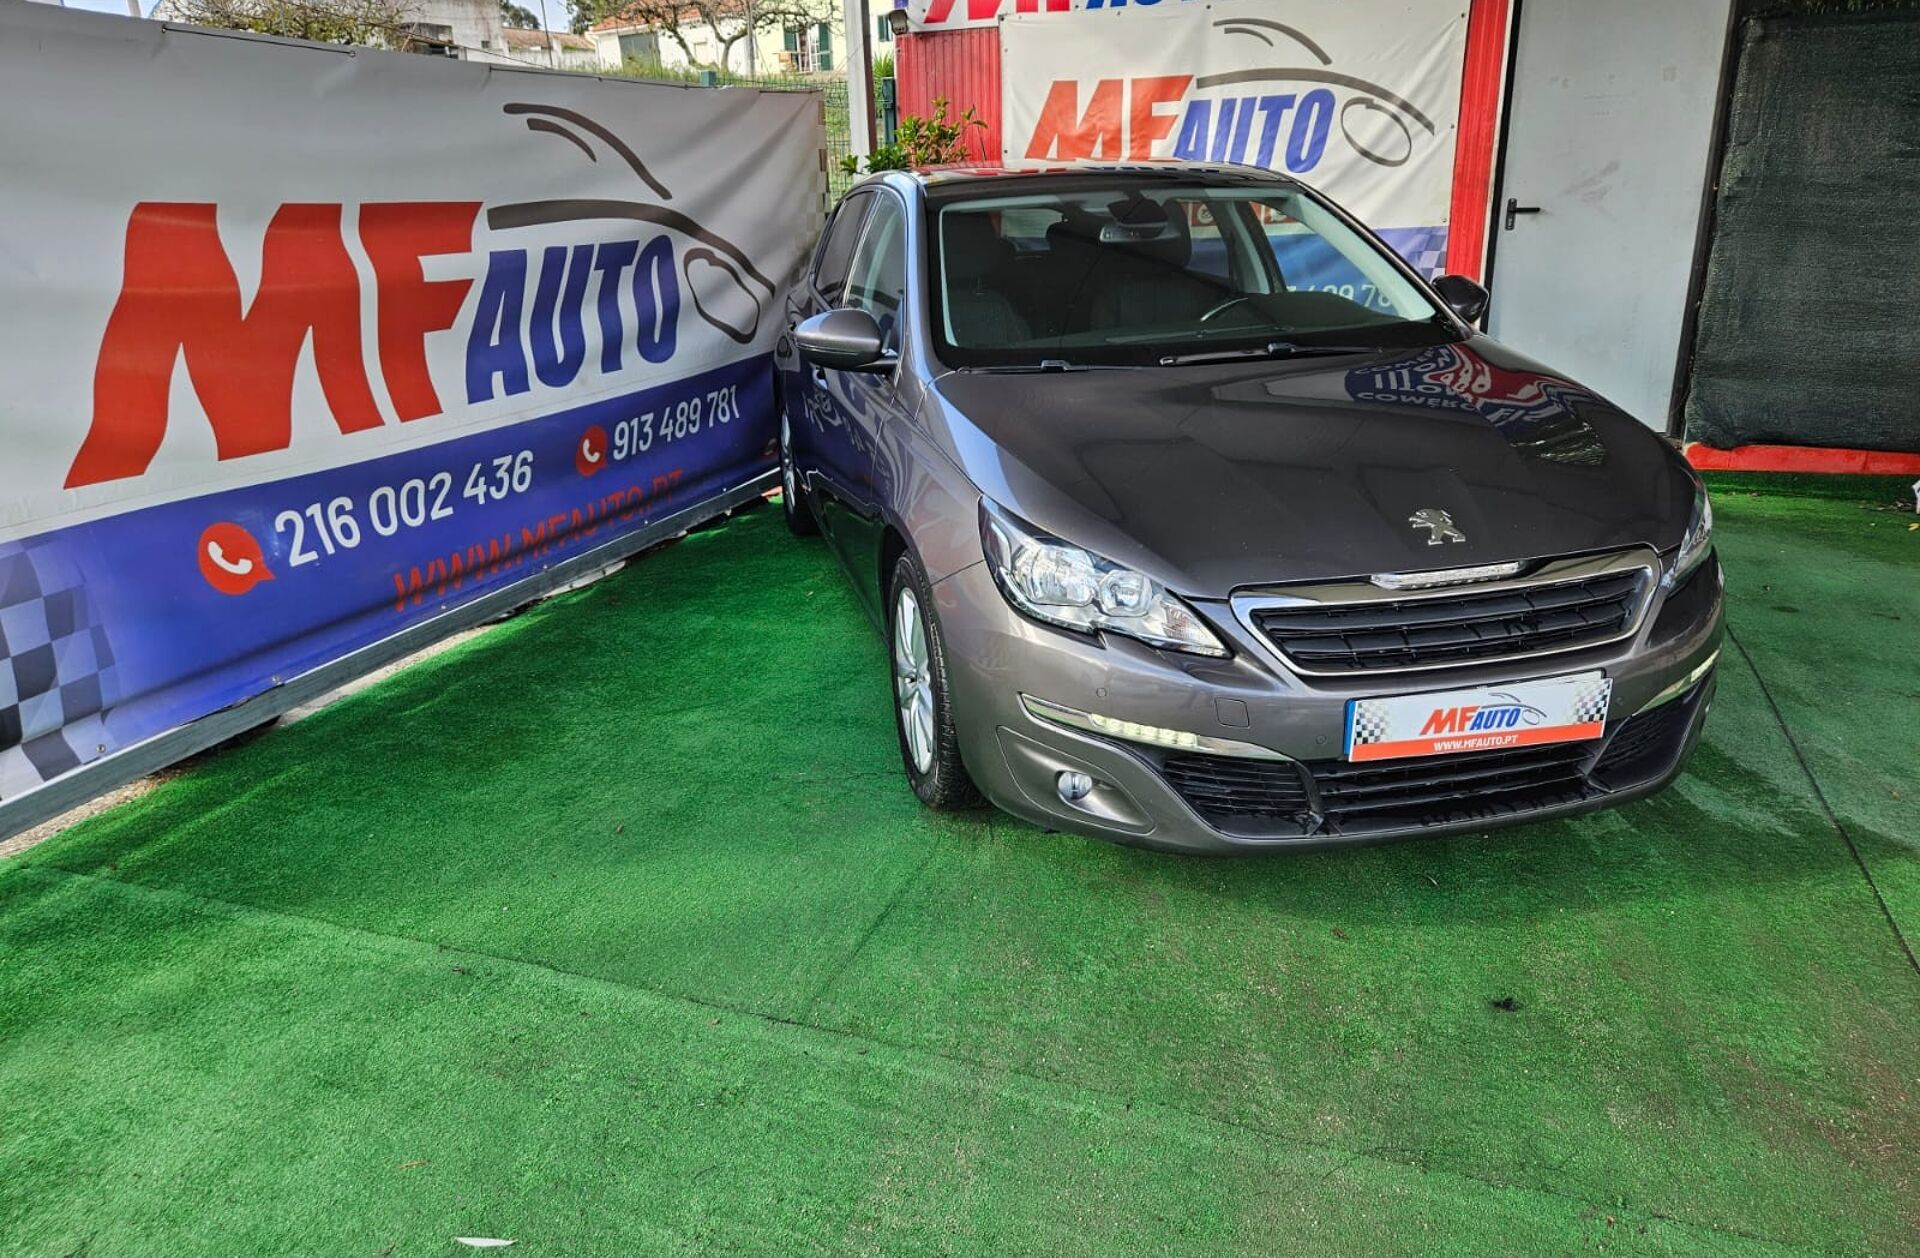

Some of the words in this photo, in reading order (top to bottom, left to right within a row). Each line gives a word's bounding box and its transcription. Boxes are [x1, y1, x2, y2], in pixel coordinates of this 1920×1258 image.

[612, 412, 654, 460] 913
[659, 397, 701, 442] 489
[707, 385, 740, 428] 781
[275, 496, 361, 567] 216
[368, 472, 454, 537] 002
[463, 450, 534, 505] 436
[1434, 735, 1518, 751] WWW.MFAUTO.PT
